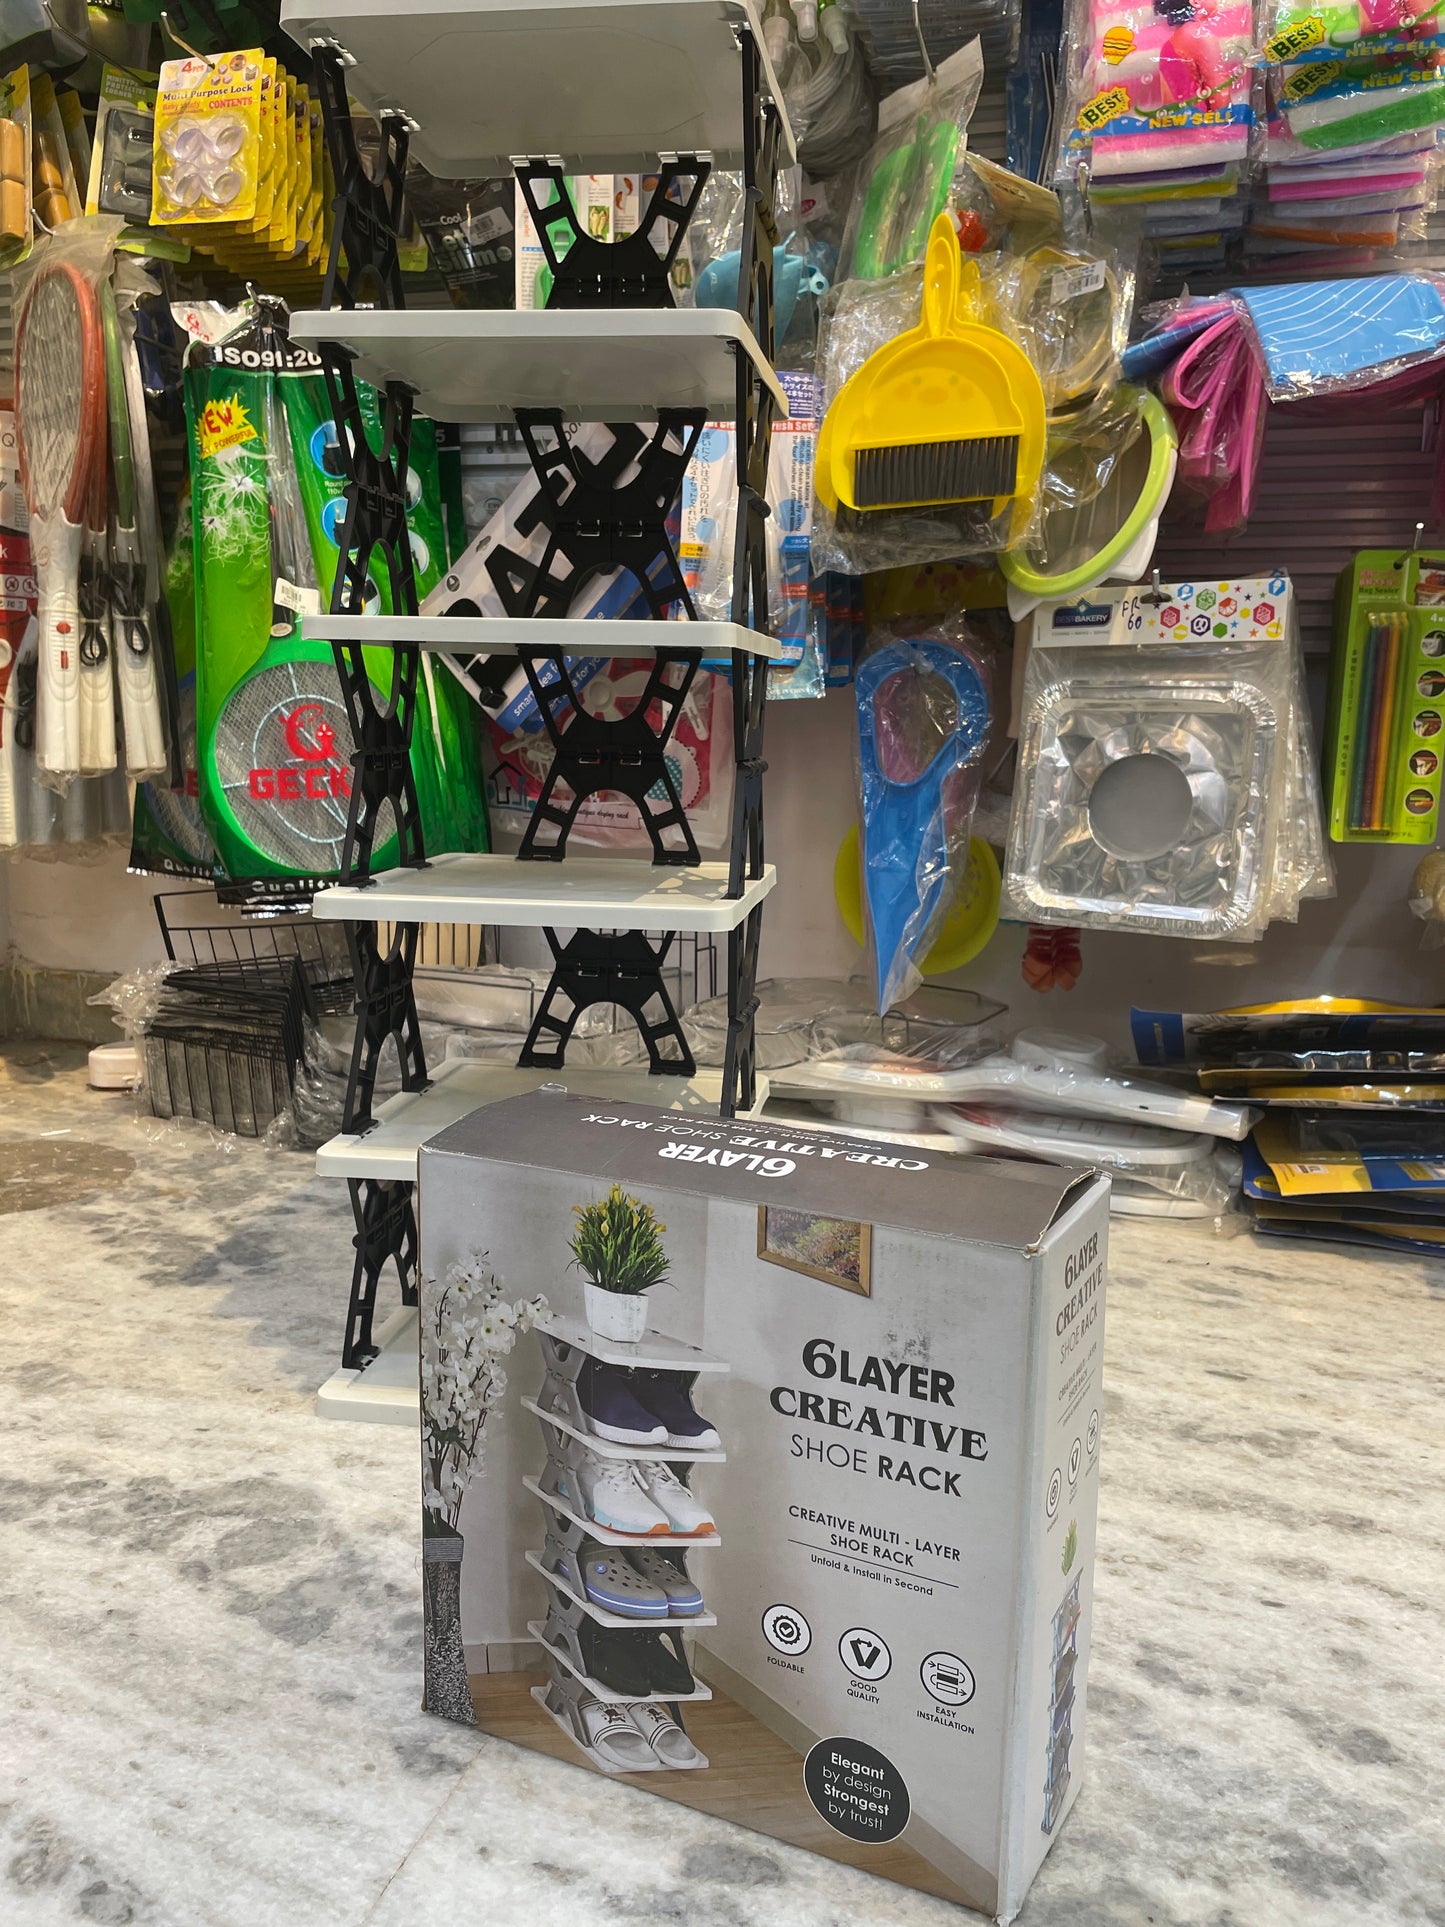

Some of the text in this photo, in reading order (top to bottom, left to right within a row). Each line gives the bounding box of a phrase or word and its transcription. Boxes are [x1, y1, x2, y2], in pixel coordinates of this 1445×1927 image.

[1272, 24, 1315, 58] BEST
[1346, 40, 1440, 57] NEW SELL
[1291, 61, 1333, 94] BEST
[1362, 69, 1445, 88] NEW SEL
[190, 87, 229, 100] Purpose
[230, 85, 254, 94] Lock
[209, 97, 253, 110] CONTENTS
[1082, 94, 1123, 126] BEST
[1149, 110, 1232, 129] NEW SELL
[440, 212, 463, 225] Cool
[214, 428, 256, 450] POWERFUL
[772, 421, 794, 431] rush
[513, 690, 534, 717] smart
[580, 1114, 654, 1130] RACK
[655, 1126, 728, 1141] SHOE
[658, 1141, 797, 1178] 6LAYER
[728, 1136, 930, 1171] CREATIVE
[1064, 1232, 1098, 1289] 6LAYER
[1056, 1262, 1103, 1337] CREATIVE
[1060, 1325, 1080, 1365] SHOE
[1080, 1301, 1098, 1337] RACK
[802, 1338, 955, 1407] 6LAYER
[770, 1387, 988, 1461] CREATIVE
[791, 1434, 961, 1497] SHOE RACK
[788, 1505, 854, 1532] CREATIVE
[859, 1524, 899, 1545] MULTI
[916, 1538, 961, 1561] LAYER
[830, 1533, 914, 1567] SHOE RACK
[811, 1554, 933, 1596] Unfold & Install in Second
[767, 1656, 805, 1674] FOLDABLE
[846, 1689, 880, 1705] QUALITY
[850, 1680, 877, 1694] GOOD
[917, 1710, 975, 1735] INSTALLATION
[935, 1706, 957, 1719] EASY
[831, 1752, 884, 1780] Elegant
[823, 1766, 892, 1800] by design
[824, 1783, 889, 1816] Strongest
[829, 1801, 883, 1831] by trust!
